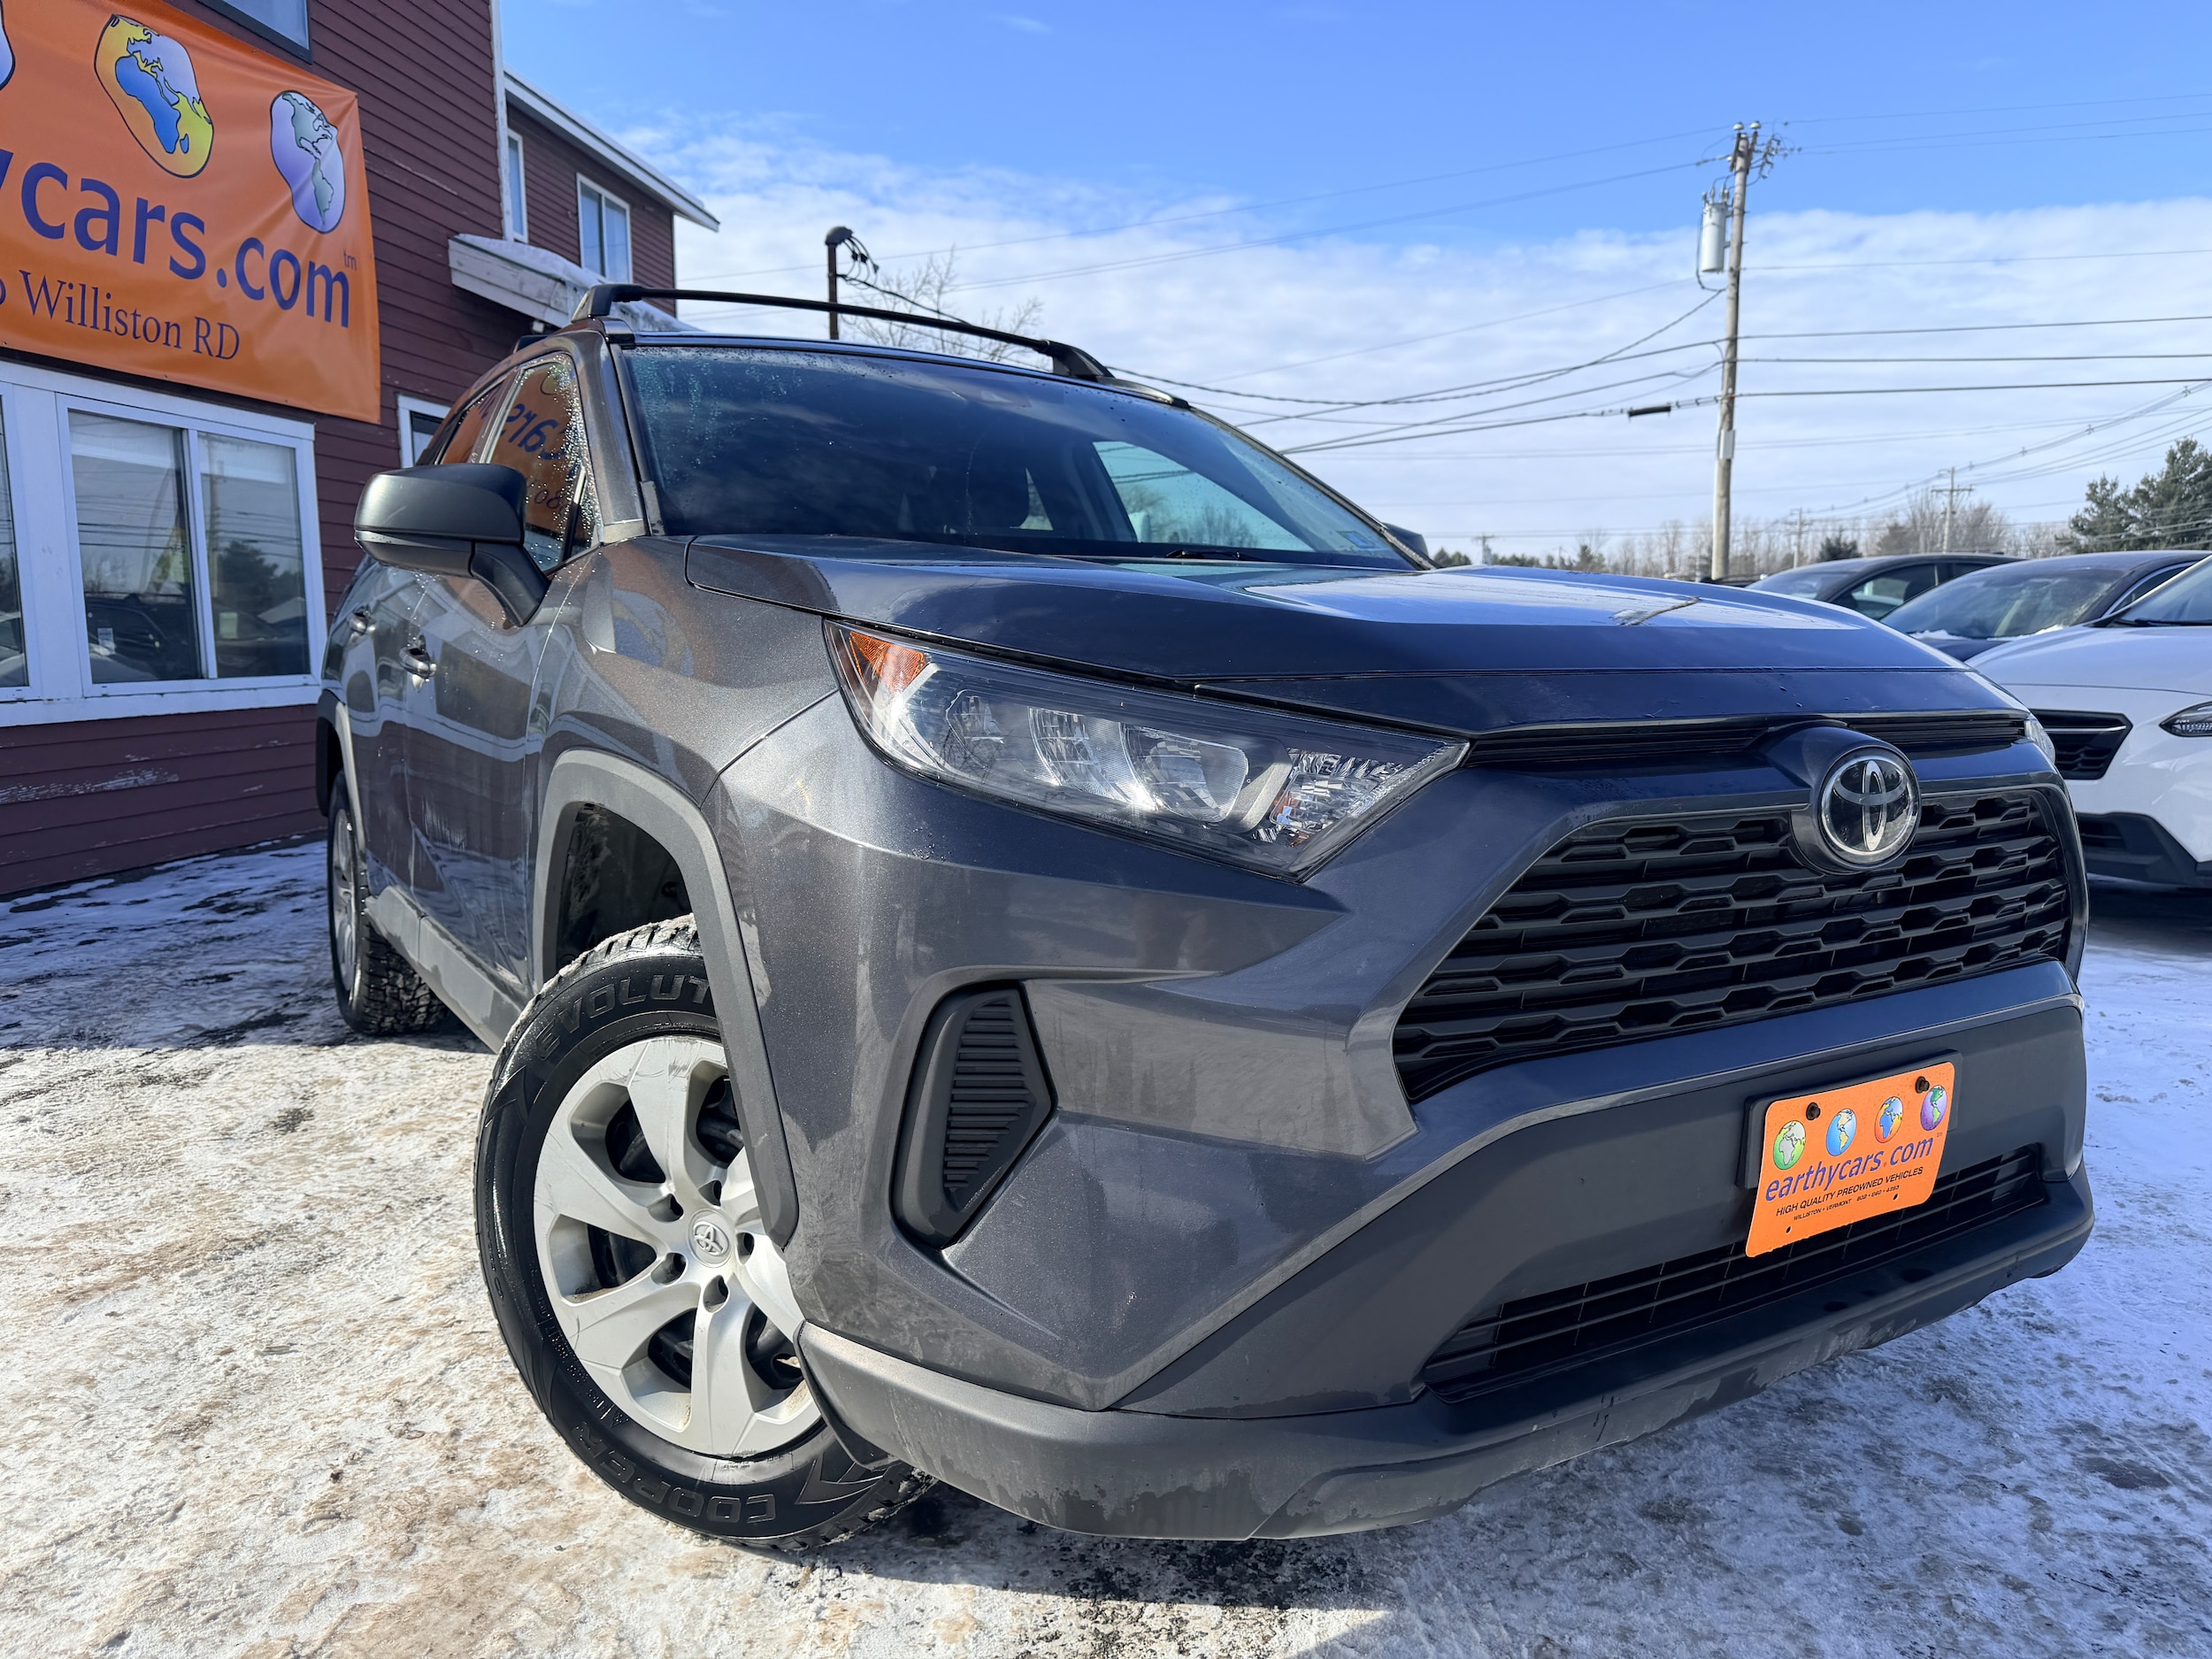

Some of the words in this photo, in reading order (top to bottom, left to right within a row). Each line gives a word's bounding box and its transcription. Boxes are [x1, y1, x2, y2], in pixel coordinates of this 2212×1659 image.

[19, 269, 181, 349] Williston
[193, 316, 240, 360] RD
[1765, 1137, 1933, 1202] earthycars.com
[1776, 1202, 1800, 1217] HIGH
[1800, 1191, 1836, 1210] QUALITY
[1837, 1179, 1884, 1198] PREOWNED
[1885, 1166, 1924, 1184] VEHICLES
[1793, 1208, 1823, 1221] WILLISTON
[1825, 1198, 1852, 1211] VERMONT
[572, 1421, 777, 1524] COOPER
